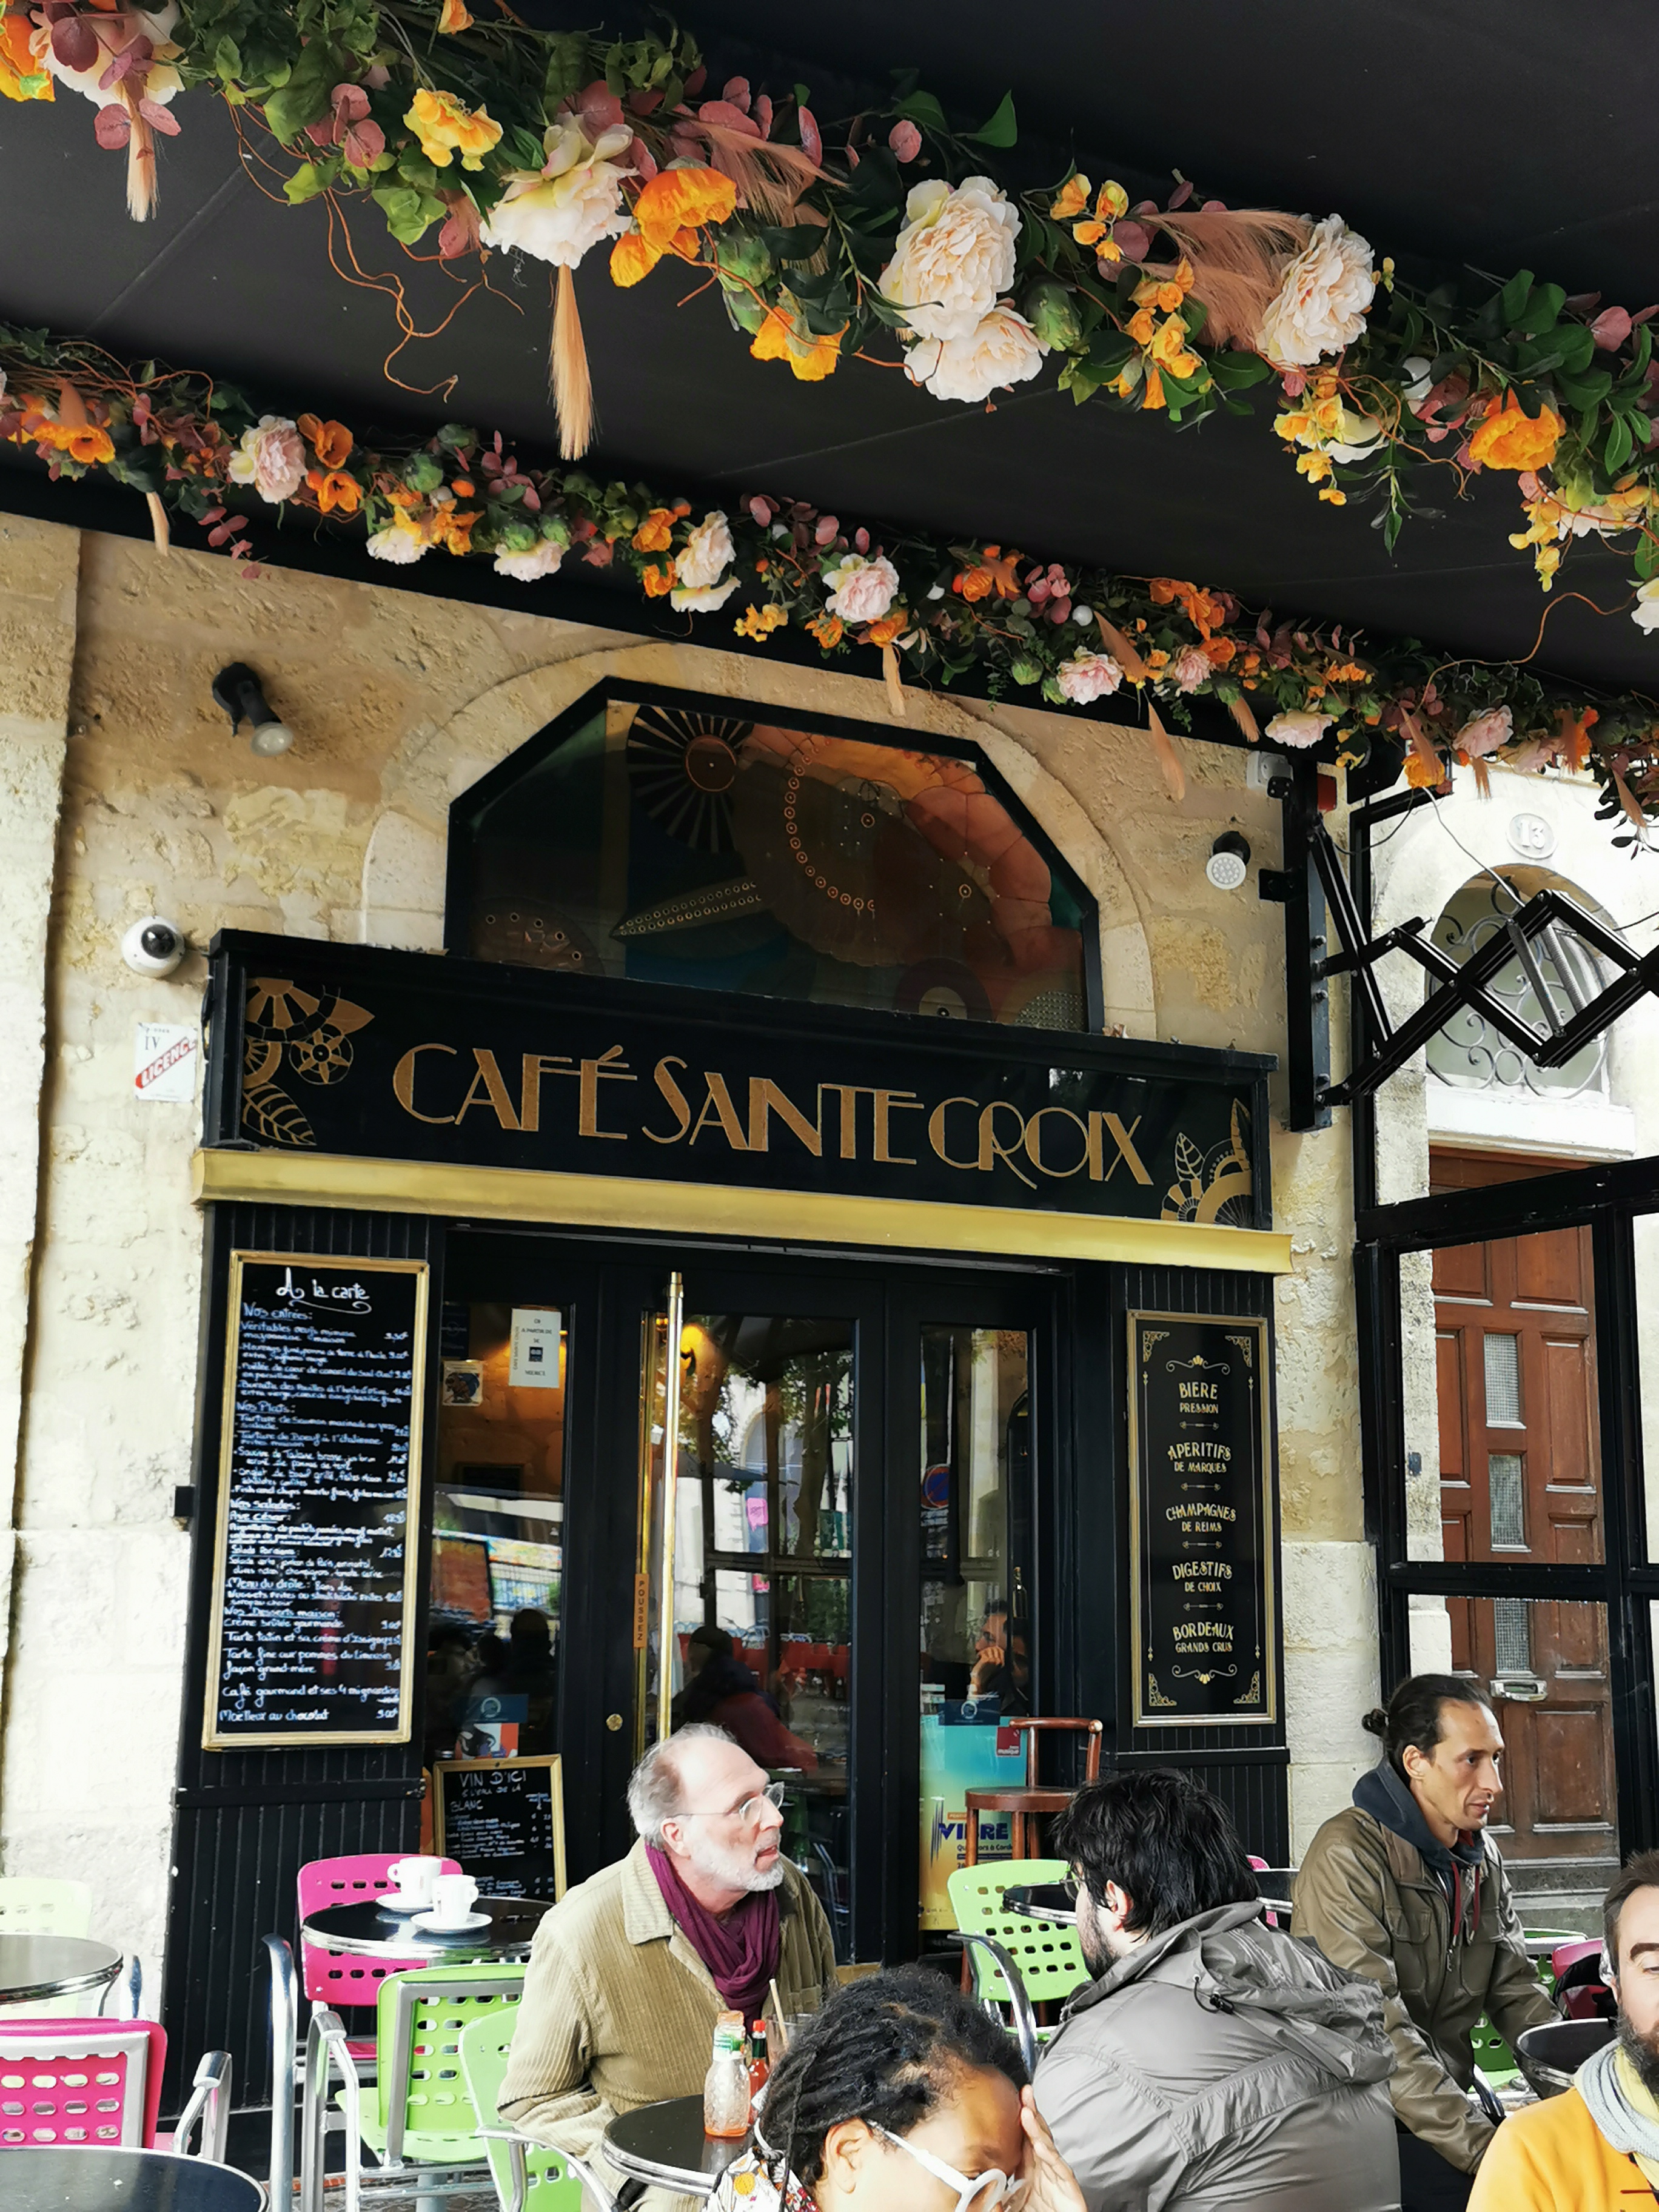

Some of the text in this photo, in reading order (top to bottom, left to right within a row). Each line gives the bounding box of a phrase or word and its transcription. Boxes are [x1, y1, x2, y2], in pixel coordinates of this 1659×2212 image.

[1517, 819, 1546, 849] 13
[393, 1044, 637, 1141] CAFÉ
[928, 1096, 1154, 1190] CROIX
[312, 1279, 330, 1298] la
[331, 1282, 370, 1299] carte
[243, 1302, 269, 1318] Nos
[1179, 1381, 1218, 1399] BIERE
[236, 1399, 258, 1411] Nos
[1179, 1402, 1219, 1414] PRESSION
[1167, 1442, 1232, 1461] APERITIFS
[1174, 1461, 1227, 1474] DE MARQUES
[1165, 1503, 1236, 1522] CHAMPAGNES
[1182, 1521, 1222, 1532] DE REIMS
[1172, 1561, 1232, 1580] DIGESTIFS
[260, 1578, 274, 1589] du
[1184, 1581, 1222, 1592] DE CHOIX
[637, 1580, 646, 1641] POUSSEZ
[224, 1618, 257, 1627] Crème
[1172, 1621, 1234, 1641] BORDEAUX
[223, 1631, 255, 1642] Tarte
[283, 1632, 296, 1642] et
[223, 1647, 255, 1659] Tarte
[298, 1651, 338, 1664] pommes
[1175, 1641, 1233, 1653] GRANDS CRUS
[222, 1682, 252, 1710] Café
[253, 1684, 306, 1709] gourmand
[307, 1684, 320, 1695] et
[268, 1712, 283, 1721] au
[284, 1708, 330, 1721] chocolat
[460, 1769, 526, 1788] VIN D'ICI
[450, 1799, 484, 1812] BLANC
[938, 1823, 1008, 1840] VIRE
